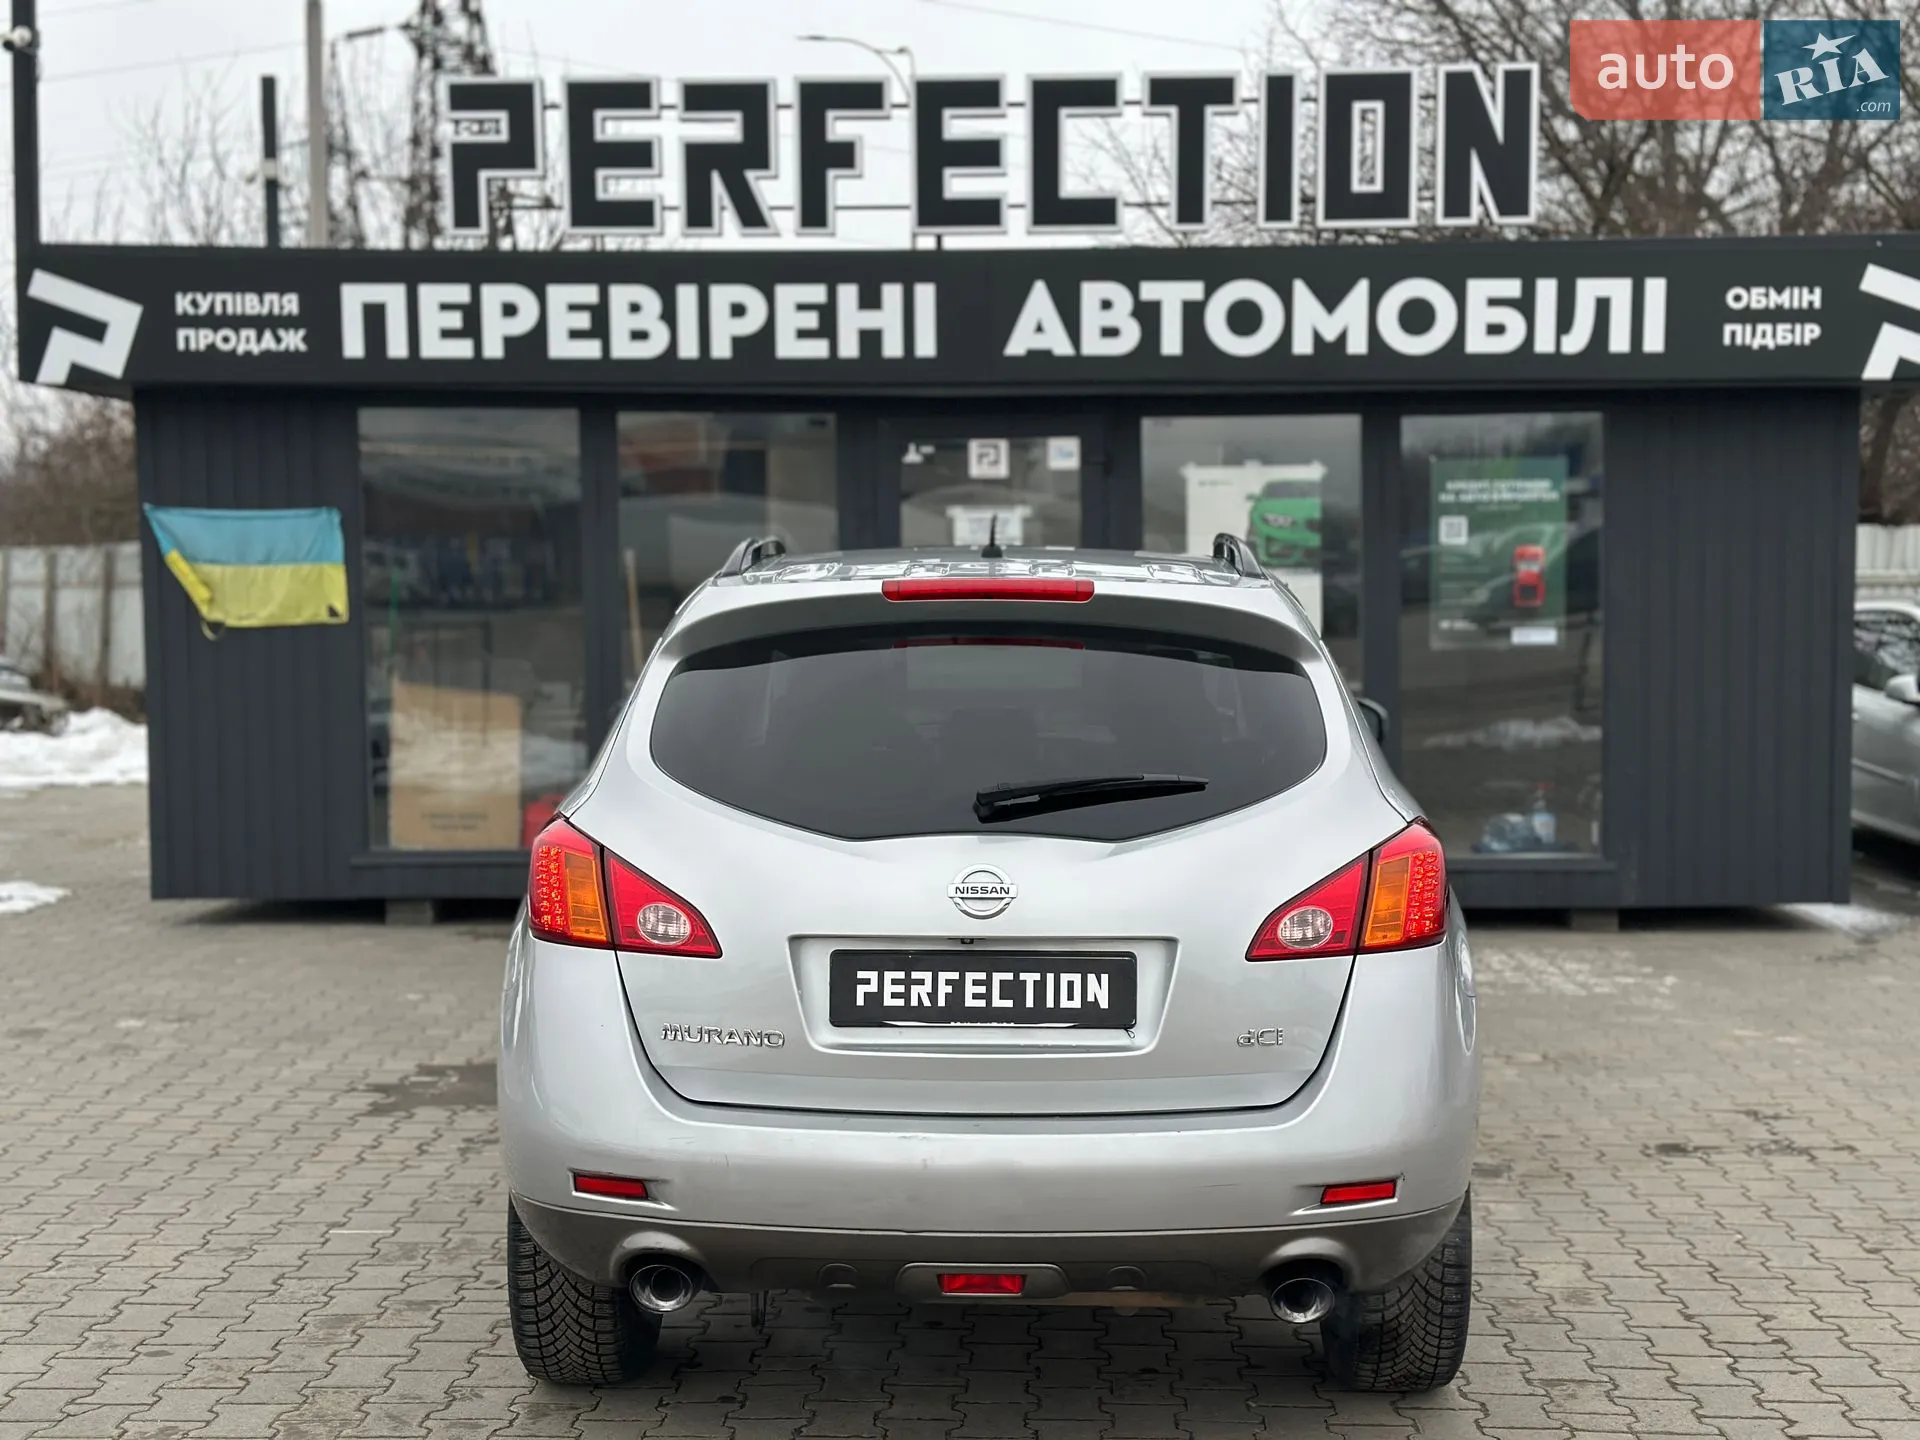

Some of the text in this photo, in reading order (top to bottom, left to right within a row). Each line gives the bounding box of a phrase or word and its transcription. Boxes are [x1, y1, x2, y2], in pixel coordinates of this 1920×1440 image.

[445, 62, 1538, 236] PERFECTION
[174, 291, 300, 317] КУПІВЛЯ
[1724, 286, 1823, 311] ОБМІН
[339, 276, 1668, 360] ПЕРЕВІРЕНІ АВТОМОБІЛІ
[176, 327, 308, 354] ПРОДАЖ
[1722, 322, 1823, 350] ПІДБІР
[954, 886, 1010, 895] NISSAN
[855, 970, 1110, 1010] PERFECTION
[660, 1022, 785, 1048] MURANO
